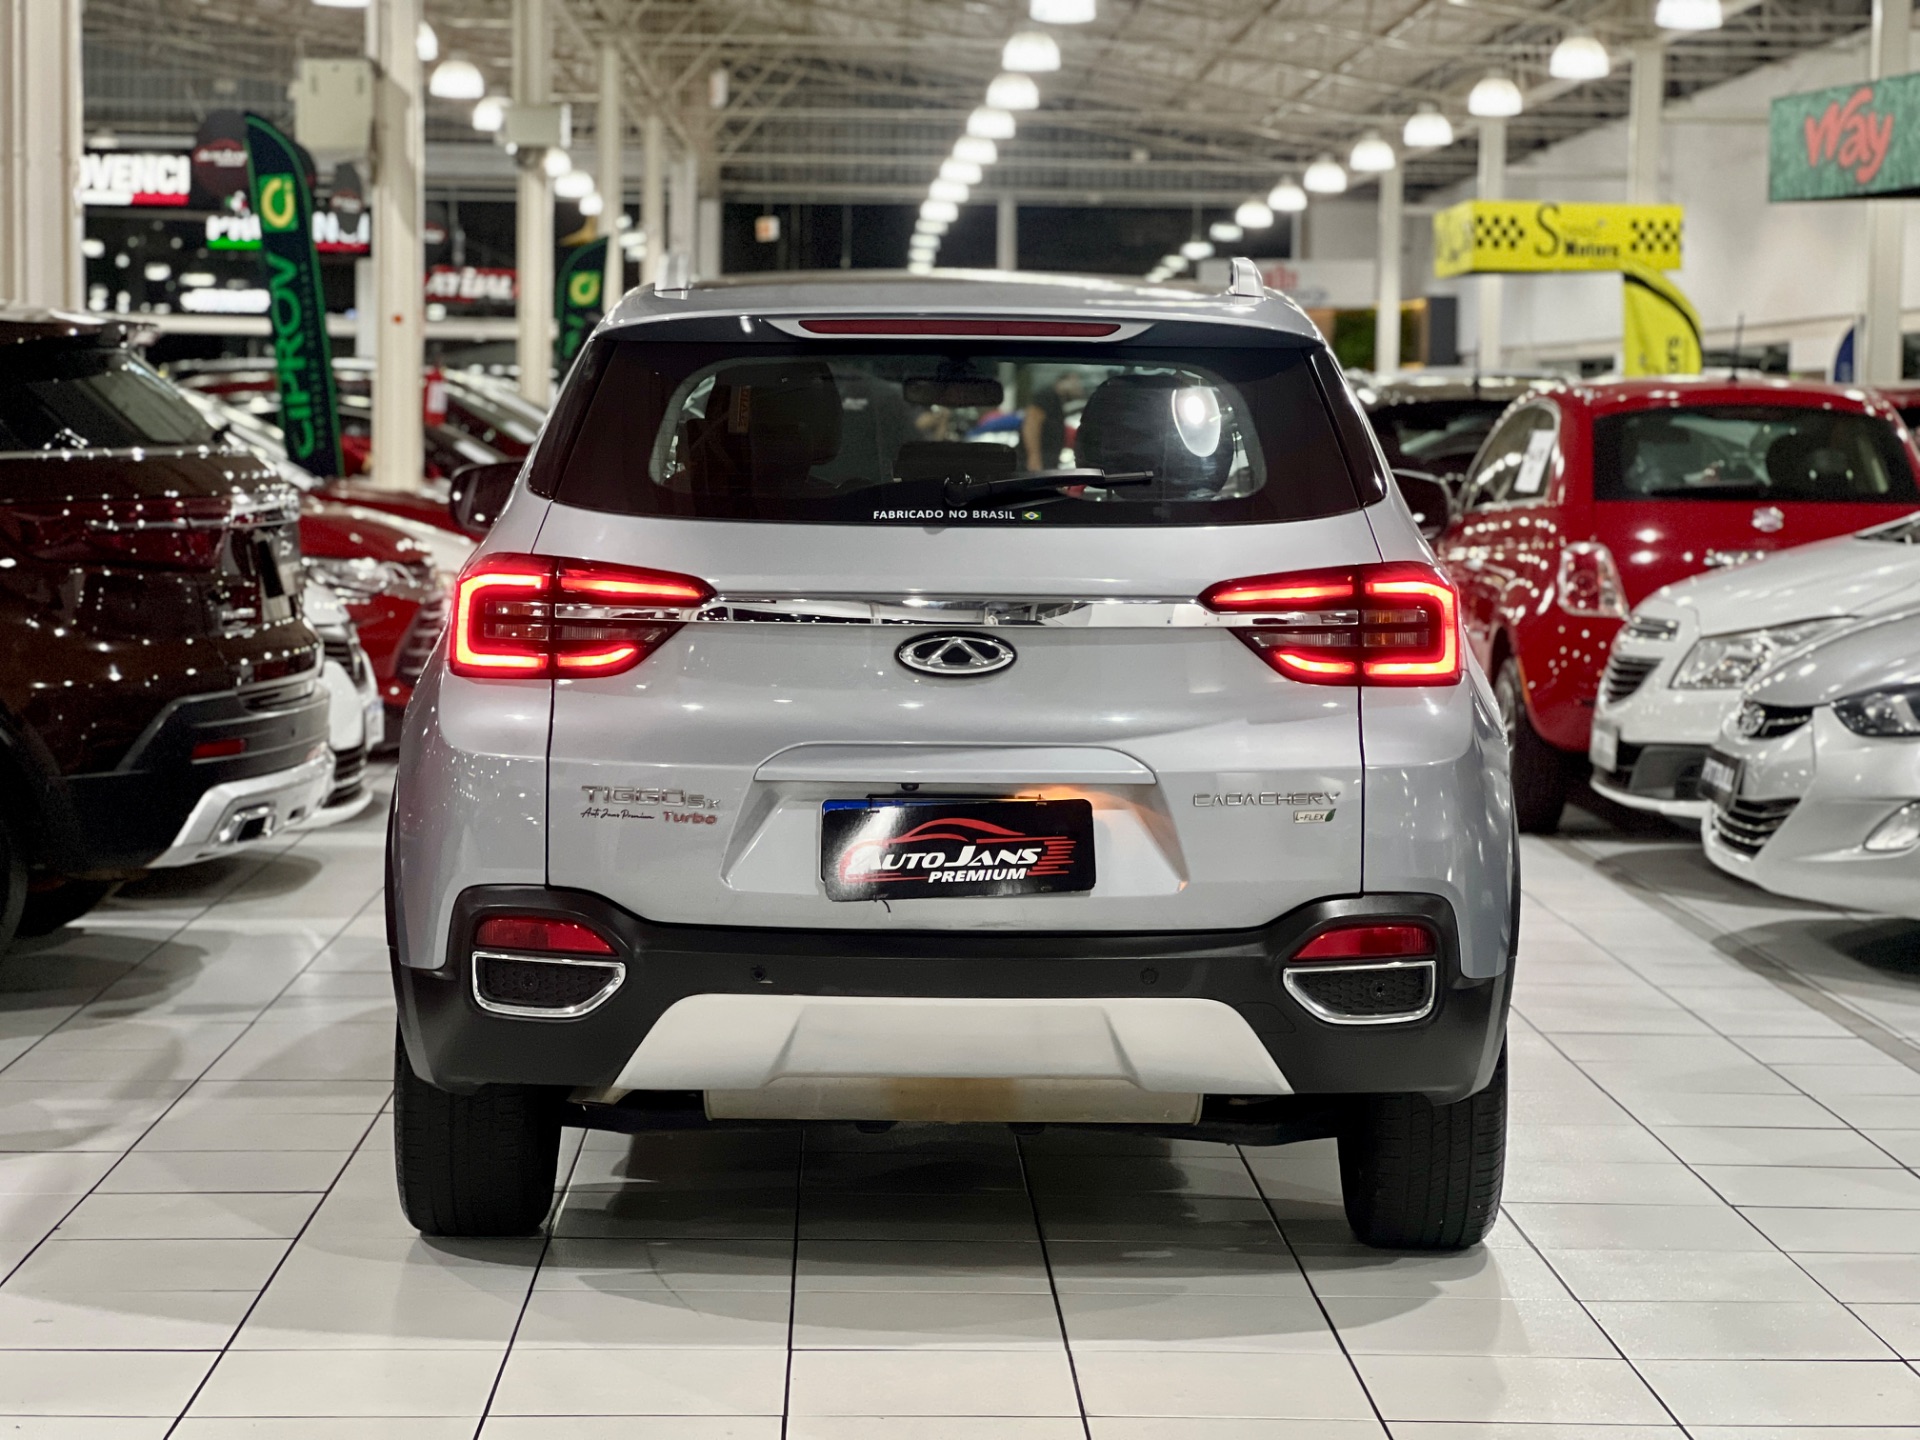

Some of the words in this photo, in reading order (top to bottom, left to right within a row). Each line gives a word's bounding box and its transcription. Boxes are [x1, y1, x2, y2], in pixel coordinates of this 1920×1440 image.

[1804, 86, 1894, 184] Way
[873, 509, 945, 520] FABRICADO
[948, 509, 969, 519] NO
[972, 510, 1016, 520] BRASIL
[663, 811, 718, 825] Turbo
[928, 868, 1027, 884] PREMIUM
